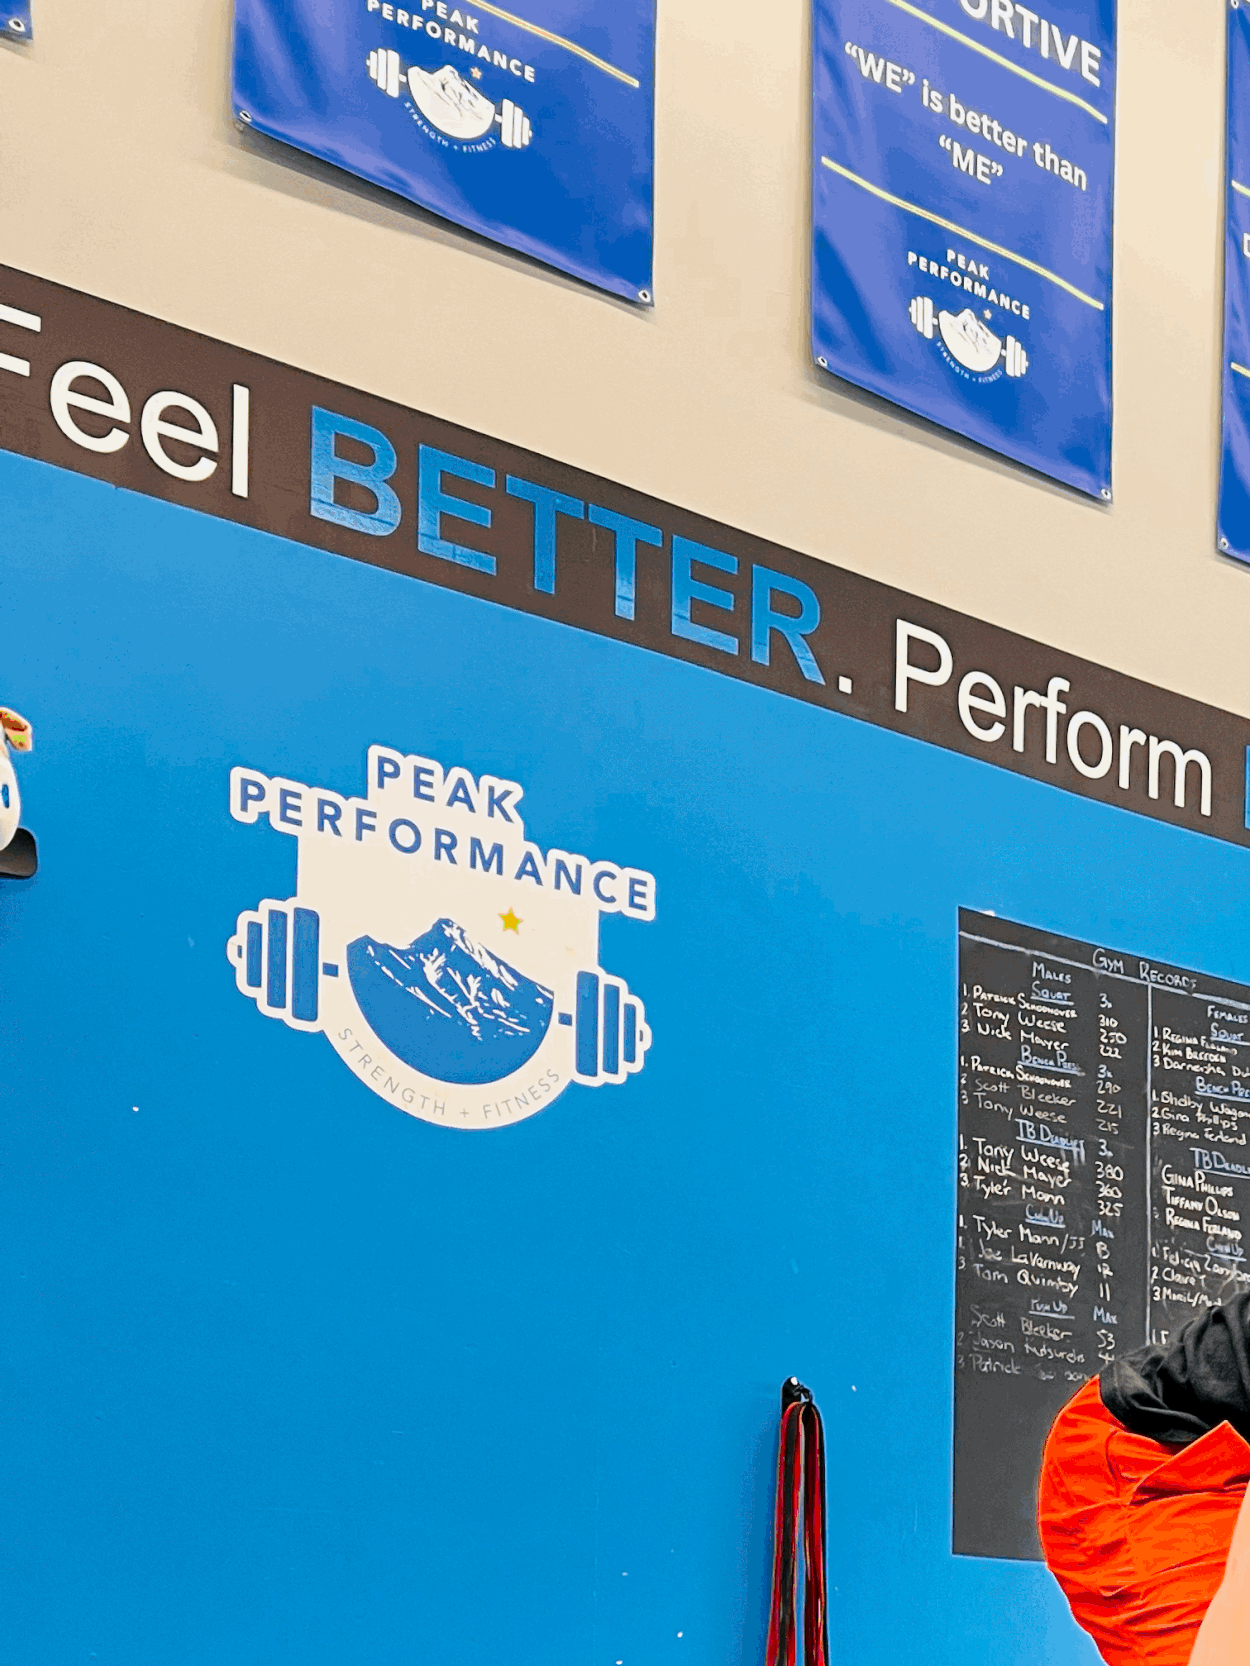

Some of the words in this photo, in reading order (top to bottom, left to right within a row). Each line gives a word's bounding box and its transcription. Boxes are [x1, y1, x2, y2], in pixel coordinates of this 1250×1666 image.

[421, 0, 479, 34] PEAK
[367, 0, 535, 83] PERFORMANCE
[922, 79, 943, 113] is
[949, 94, 1028, 157] better
[1033, 142, 1088, 191] than
[946, 249, 989, 281] PEAK
[907, 251, 1030, 320] PERFORMANCE
[310, 404, 853, 694] BETTER.
[893, 618, 1212, 816] Perform
[376, 756, 515, 823] PEAK
[240, 777, 649, 911] PERFORMANCE
[973, 1003, 1009, 1027] Tony
[1099, 1014, 1118, 1028] 310
[977, 1023, 1012, 1041] Nick
[1020, 1030, 1069, 1050] Mayer
[337, 1027, 446, 1117] STRENGTH
[482, 1068, 560, 1119] FITNESS
[1097, 1080, 1121, 1095] 290
[973, 1092, 1014, 1121] Tony
[1095, 1118, 1119, 1135] 215
[975, 1078, 1010, 1093] Scott
[1097, 1100, 1122, 1119] 221
[1161, 1108, 1190, 1122] Gina
[972, 1137, 1014, 1167] Tony
[1094, 1161, 1124, 1181] 380
[978, 1156, 1016, 1177] Nick
[1023, 1165, 1072, 1189] Mayer
[1095, 1181, 1123, 1199] 360
[1097, 1200, 1123, 1217] 325
[973, 1215, 1012, 1241] Tyler
[1097, 1329, 1115, 1350] 53
[969, 1354, 1021, 1375] Patrick
